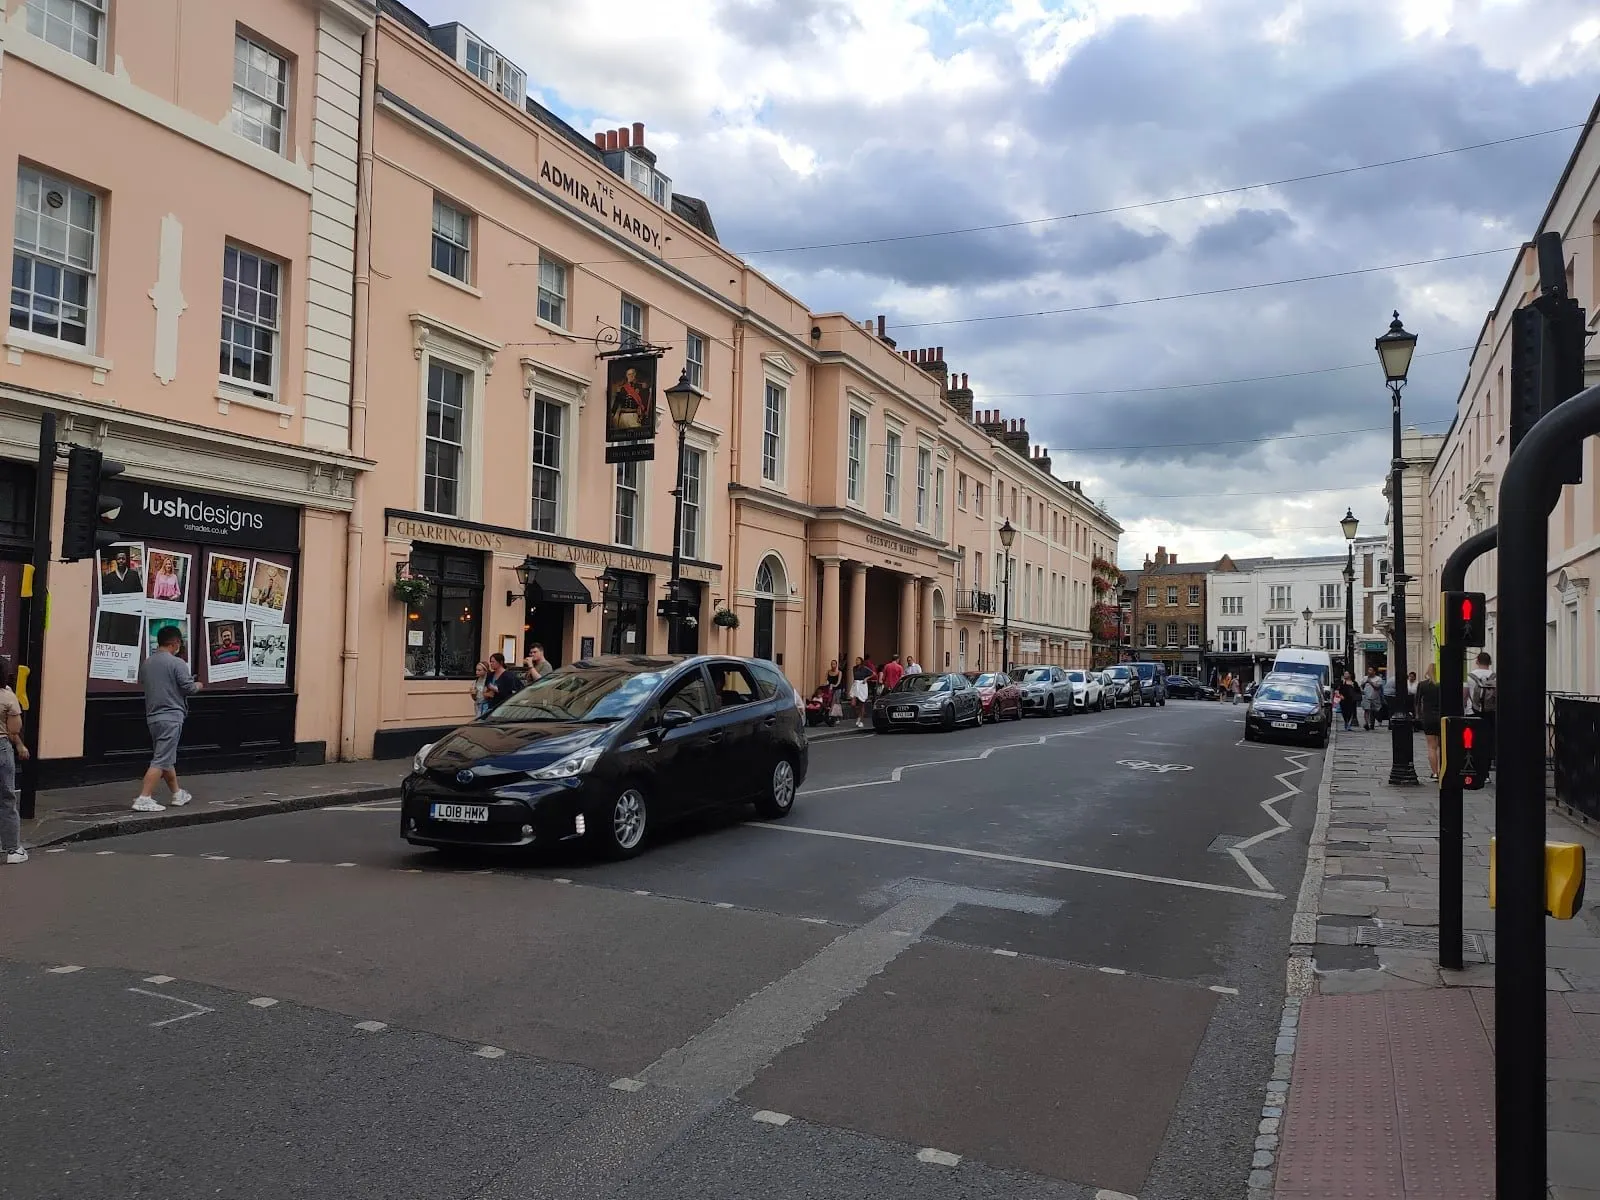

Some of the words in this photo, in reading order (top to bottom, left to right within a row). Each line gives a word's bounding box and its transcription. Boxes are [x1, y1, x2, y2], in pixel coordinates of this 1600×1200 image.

[541, 160, 608, 217] ADMIRAL
[596, 180, 614, 200] THE
[142, 492, 264, 532] lushdesigns
[397, 521, 503, 549] CHARRINGTON'S
[534, 541, 557, 559] THE
[565, 546, 613, 568] ADMIRAL
[620, 555, 655, 573] HARDY
[698, 569, 714, 581] ALE
[866, 534, 897, 550] GREENWICH
[900, 544, 917, 556] MARKET
[439, 805, 461, 817] LO18
[465, 806, 485, 819] HMK
